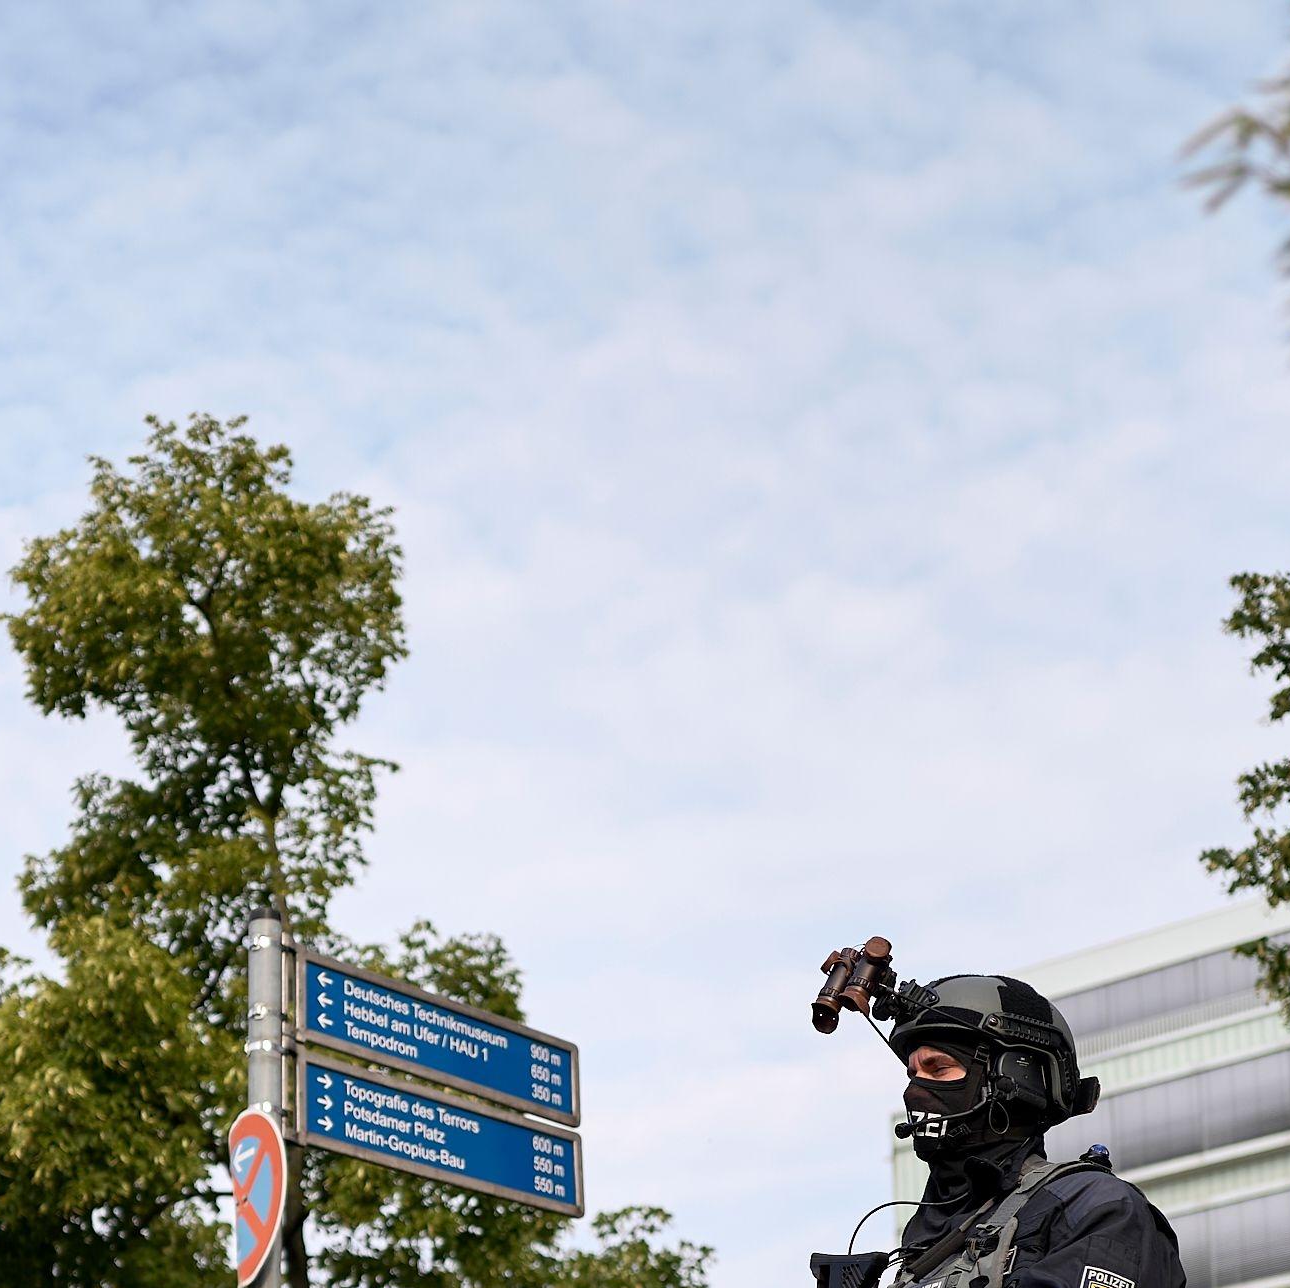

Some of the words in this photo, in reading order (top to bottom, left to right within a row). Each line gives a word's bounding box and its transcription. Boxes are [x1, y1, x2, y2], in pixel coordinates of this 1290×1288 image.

[343, 979, 409, 1016] Deutsches
[412, 1003, 508, 1049] Technikmuseum
[530, 1043, 550, 1063] 900
[550, 1053, 562, 1066] m
[343, 1000, 388, 1029] Hebbel
[391, 1019, 411, 1037] am
[414, 1024, 440, 1047] Ufer
[450, 1036, 478, 1059] HAU
[482, 1047, 489, 1063] 1
[530, 1063, 550, 1083] 650
[551, 1073, 562, 1087] m
[344, 1020, 418, 1059] Tempodrom
[531, 1083, 550, 1102] 350
[551, 1093, 562, 1106] m
[343, 1079, 409, 1114] Topografie
[412, 1099, 434, 1120] des
[437, 1107, 480, 1134] Terrors
[532, 1135, 552, 1153] 600
[553, 1144, 564, 1157] m
[343, 1101, 410, 1134] Potsdamer
[414, 1122, 446, 1145] Platz
[554, 1165, 565, 1177] m
[345, 1122, 466, 1170] Martin-Gropius-Bau
[555, 1184, 565, 1197] m
